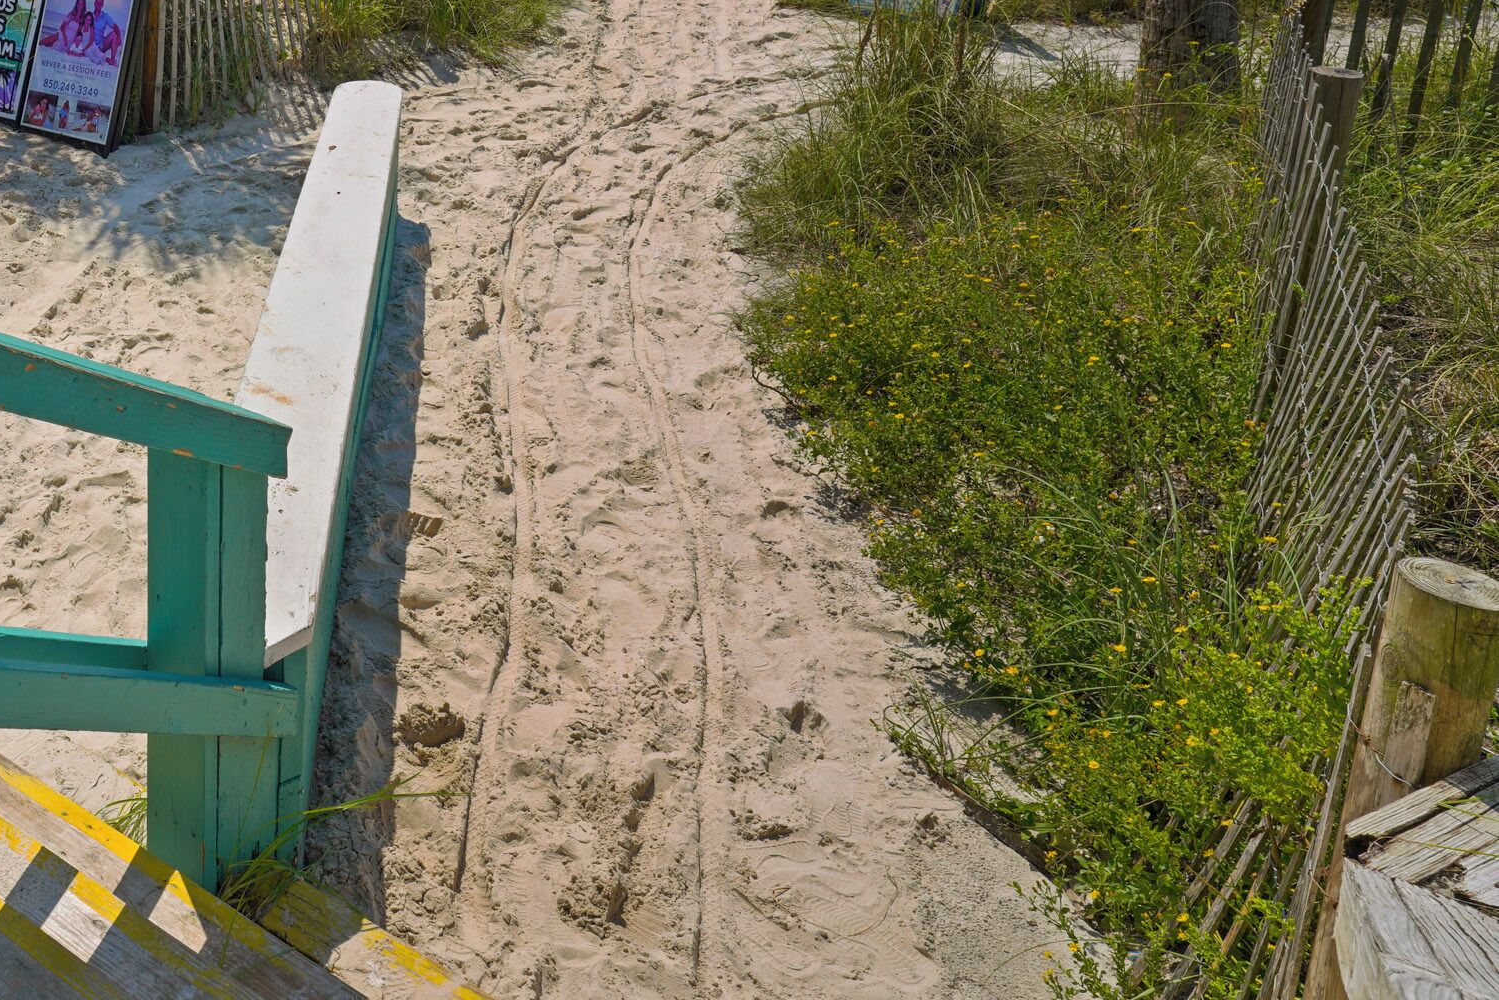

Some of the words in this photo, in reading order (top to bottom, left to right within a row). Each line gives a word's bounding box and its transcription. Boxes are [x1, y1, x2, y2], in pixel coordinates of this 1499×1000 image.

[41, 60, 61, 68] NEVER
[68, 64, 95, 75] SESSION
[43, 79, 99, 98] 850.249.3349
